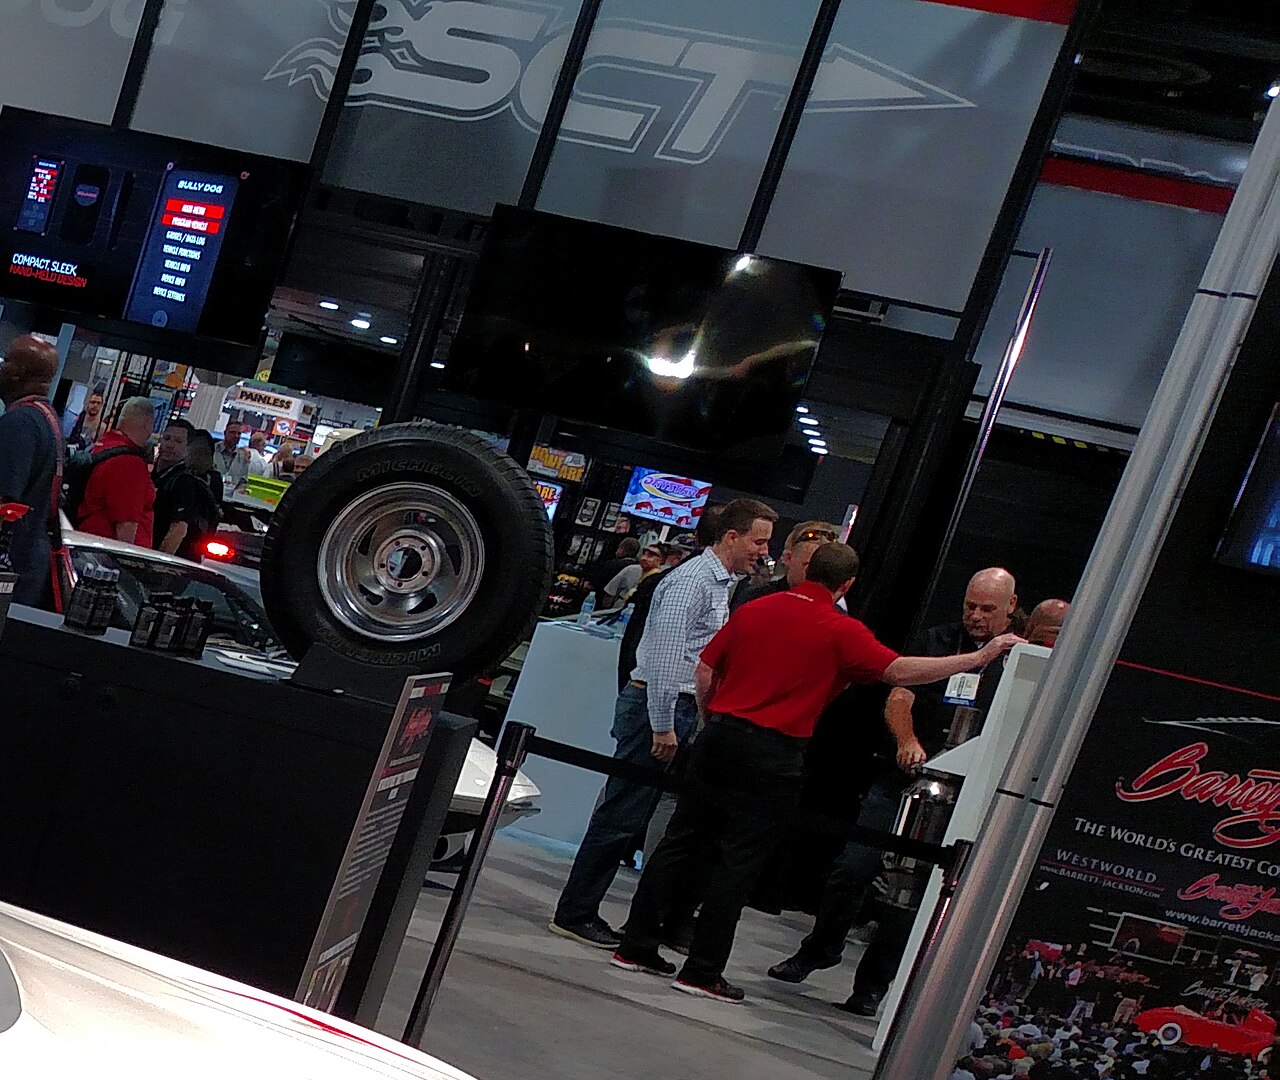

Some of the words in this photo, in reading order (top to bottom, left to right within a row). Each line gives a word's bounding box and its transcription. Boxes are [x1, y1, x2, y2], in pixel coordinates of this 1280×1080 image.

[178, 180, 204, 191] BULLY
[204, 184, 223, 194] DOG
[10, 265, 56, 282] HAND-HELD
[57, 273, 87, 287] DESIGN
[51, 261, 78, 276] SLEEK
[240, 391, 293, 409] PAINLESS
[1074, 817, 1106, 837] THE
[1110, 825, 1177, 853] WORLD'S
[1180, 843, 1256, 871] GREATEST
[1056, 849, 1157, 884] WESTWORLD
